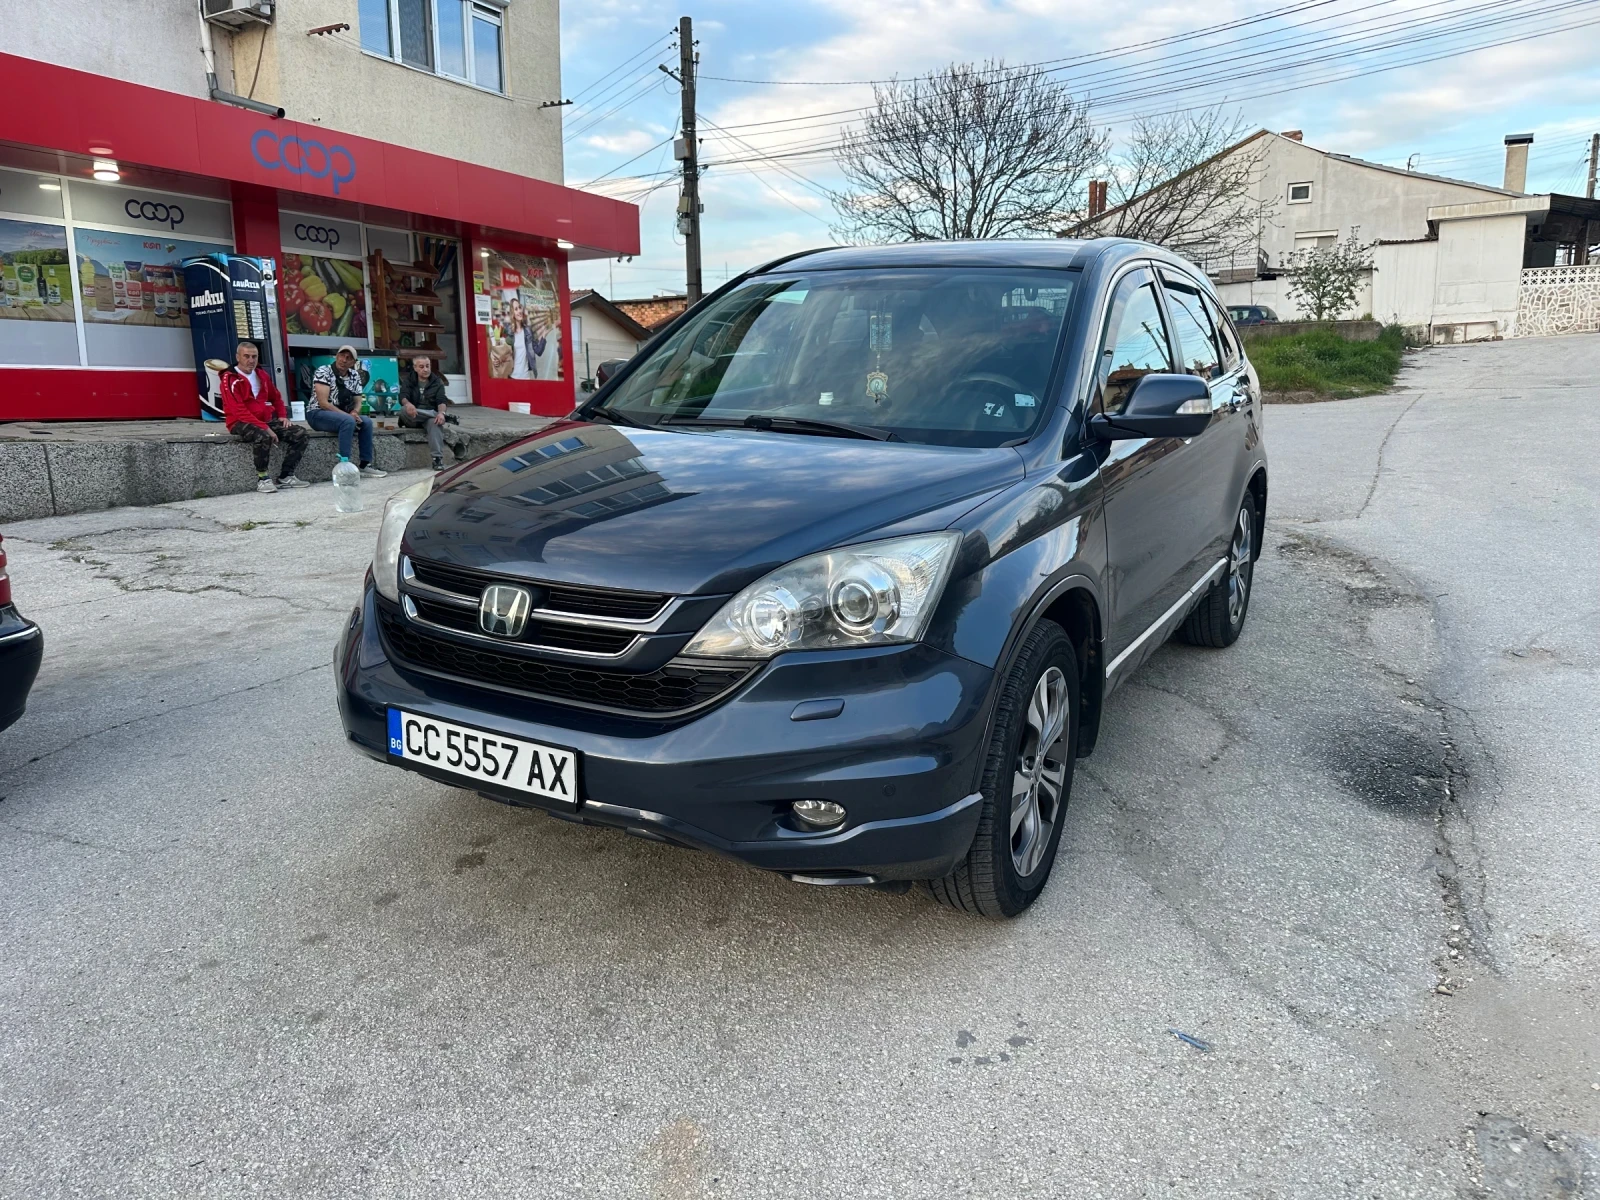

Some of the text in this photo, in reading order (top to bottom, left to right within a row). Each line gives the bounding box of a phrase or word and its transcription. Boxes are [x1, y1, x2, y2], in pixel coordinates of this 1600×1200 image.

[251, 129, 356, 195] coop
[125, 199, 184, 230] coop
[294, 223, 340, 250] coop
[232, 279, 261, 289] LAVAZZA
[390, 737, 402, 750] BG
